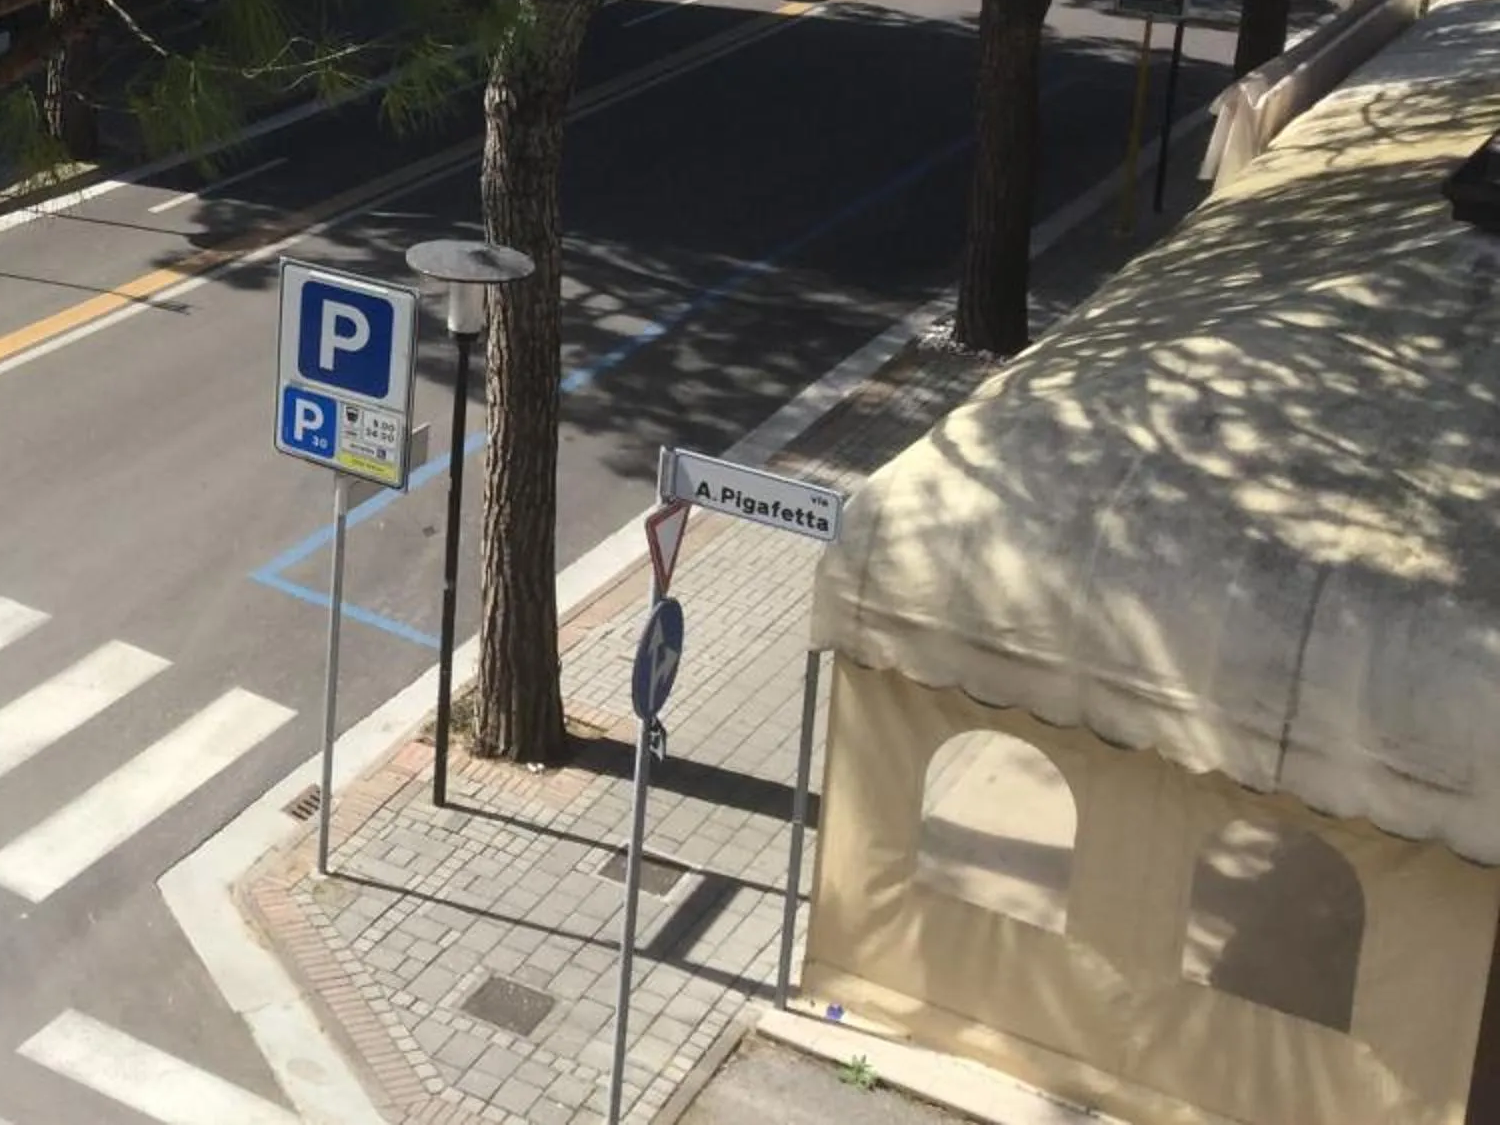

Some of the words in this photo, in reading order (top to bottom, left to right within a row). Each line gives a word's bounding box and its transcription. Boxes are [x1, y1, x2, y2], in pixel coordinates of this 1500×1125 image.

[320, 299, 371, 371] P
[293, 397, 324, 441] P
[811, 495, 828, 507] via
